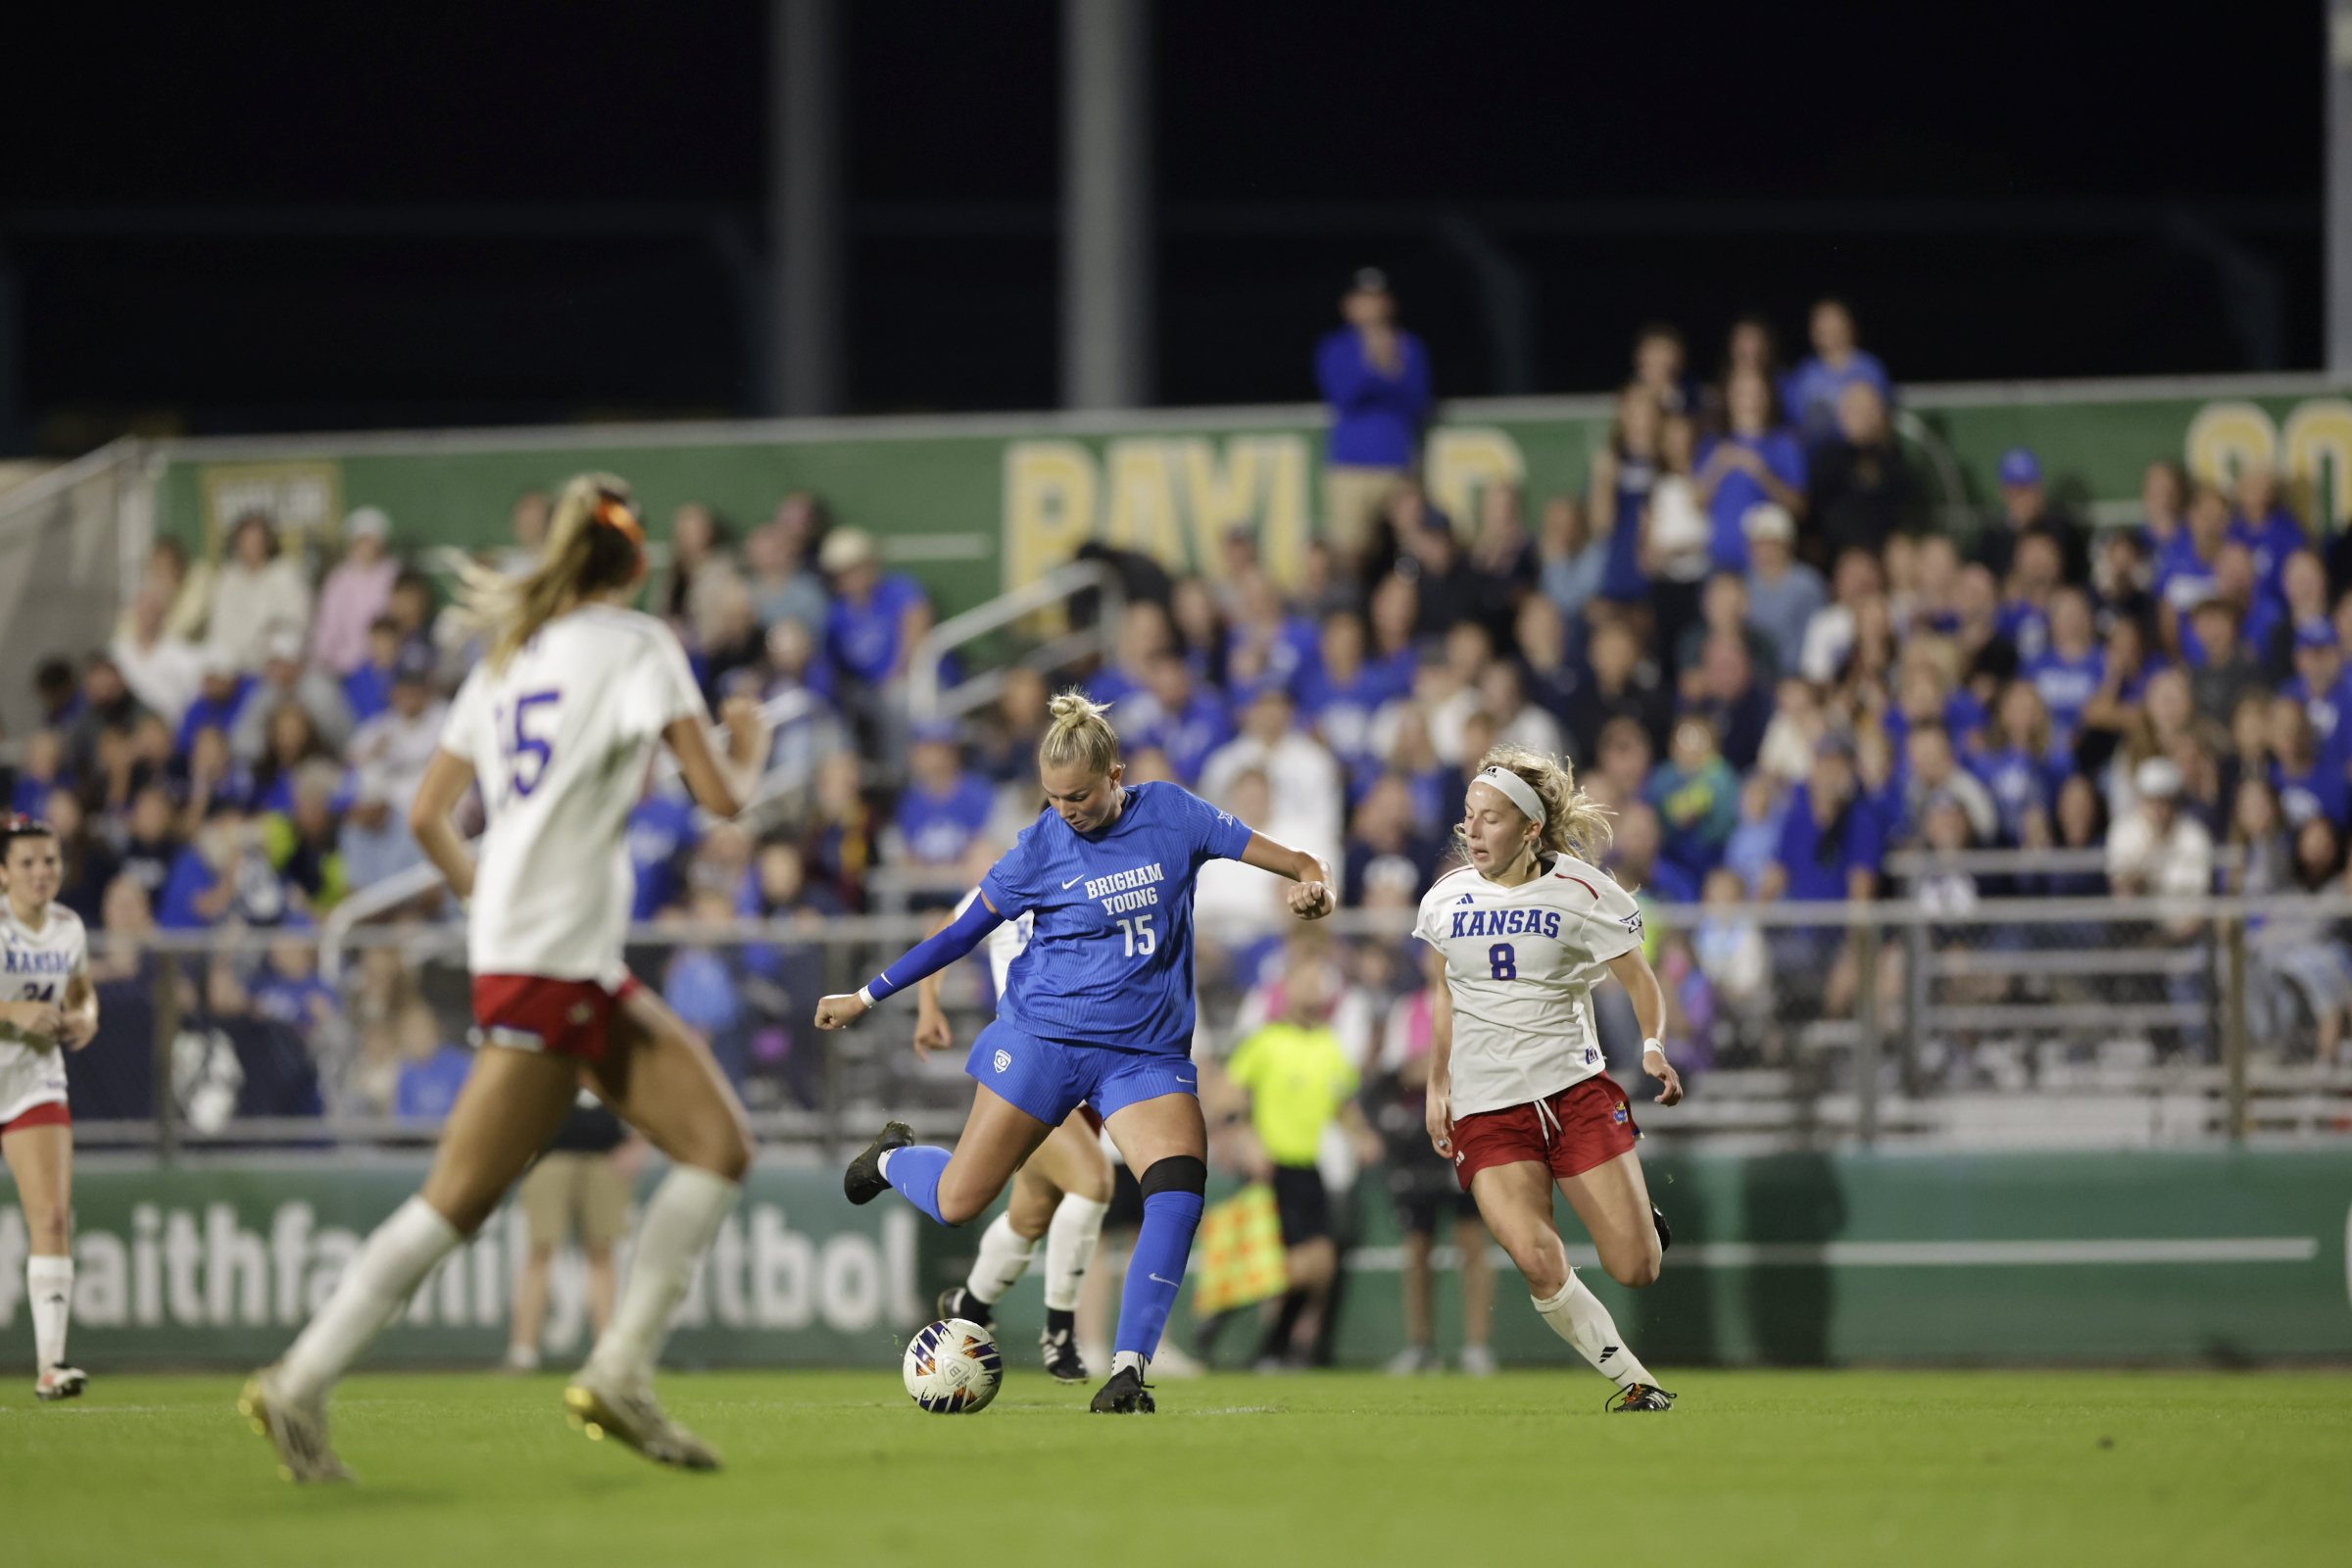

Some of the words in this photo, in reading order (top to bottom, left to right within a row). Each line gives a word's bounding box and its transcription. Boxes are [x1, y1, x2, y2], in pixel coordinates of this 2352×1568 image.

[1001, 425, 1527, 639] BAYLR
[1085, 862, 1164, 900] BRIGHAM
[1102, 887, 1158, 915] YOUNG
[1116, 914, 1155, 956] 15
[1450, 909, 1561, 939] KANSAS
[1489, 943, 1516, 980] 8
[956, 1374, 970, 1388] NCAA
